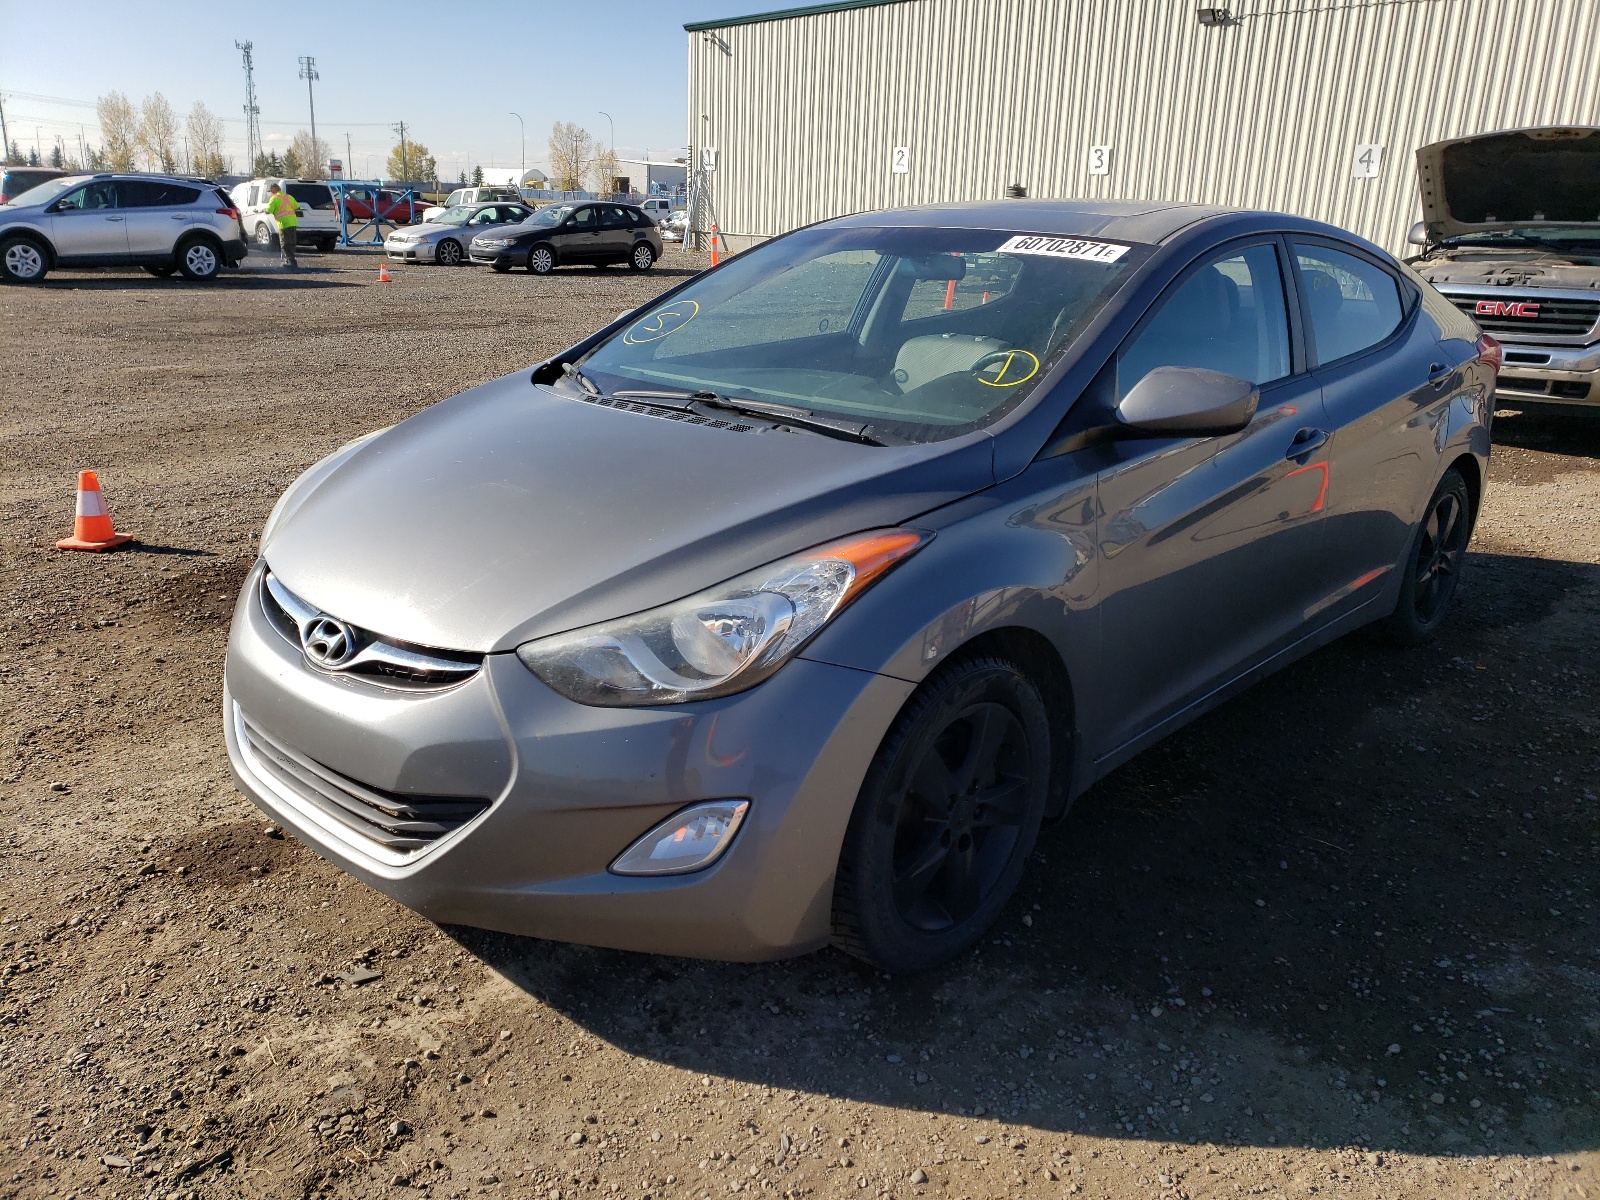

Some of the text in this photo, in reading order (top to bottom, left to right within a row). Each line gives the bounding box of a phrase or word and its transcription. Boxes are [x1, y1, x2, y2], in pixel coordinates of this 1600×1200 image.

[896, 149, 905, 167] 2
[1094, 148, 1104, 169] 3
[1358, 148, 1374, 173] 4
[1475, 300, 1540, 318] GMC
